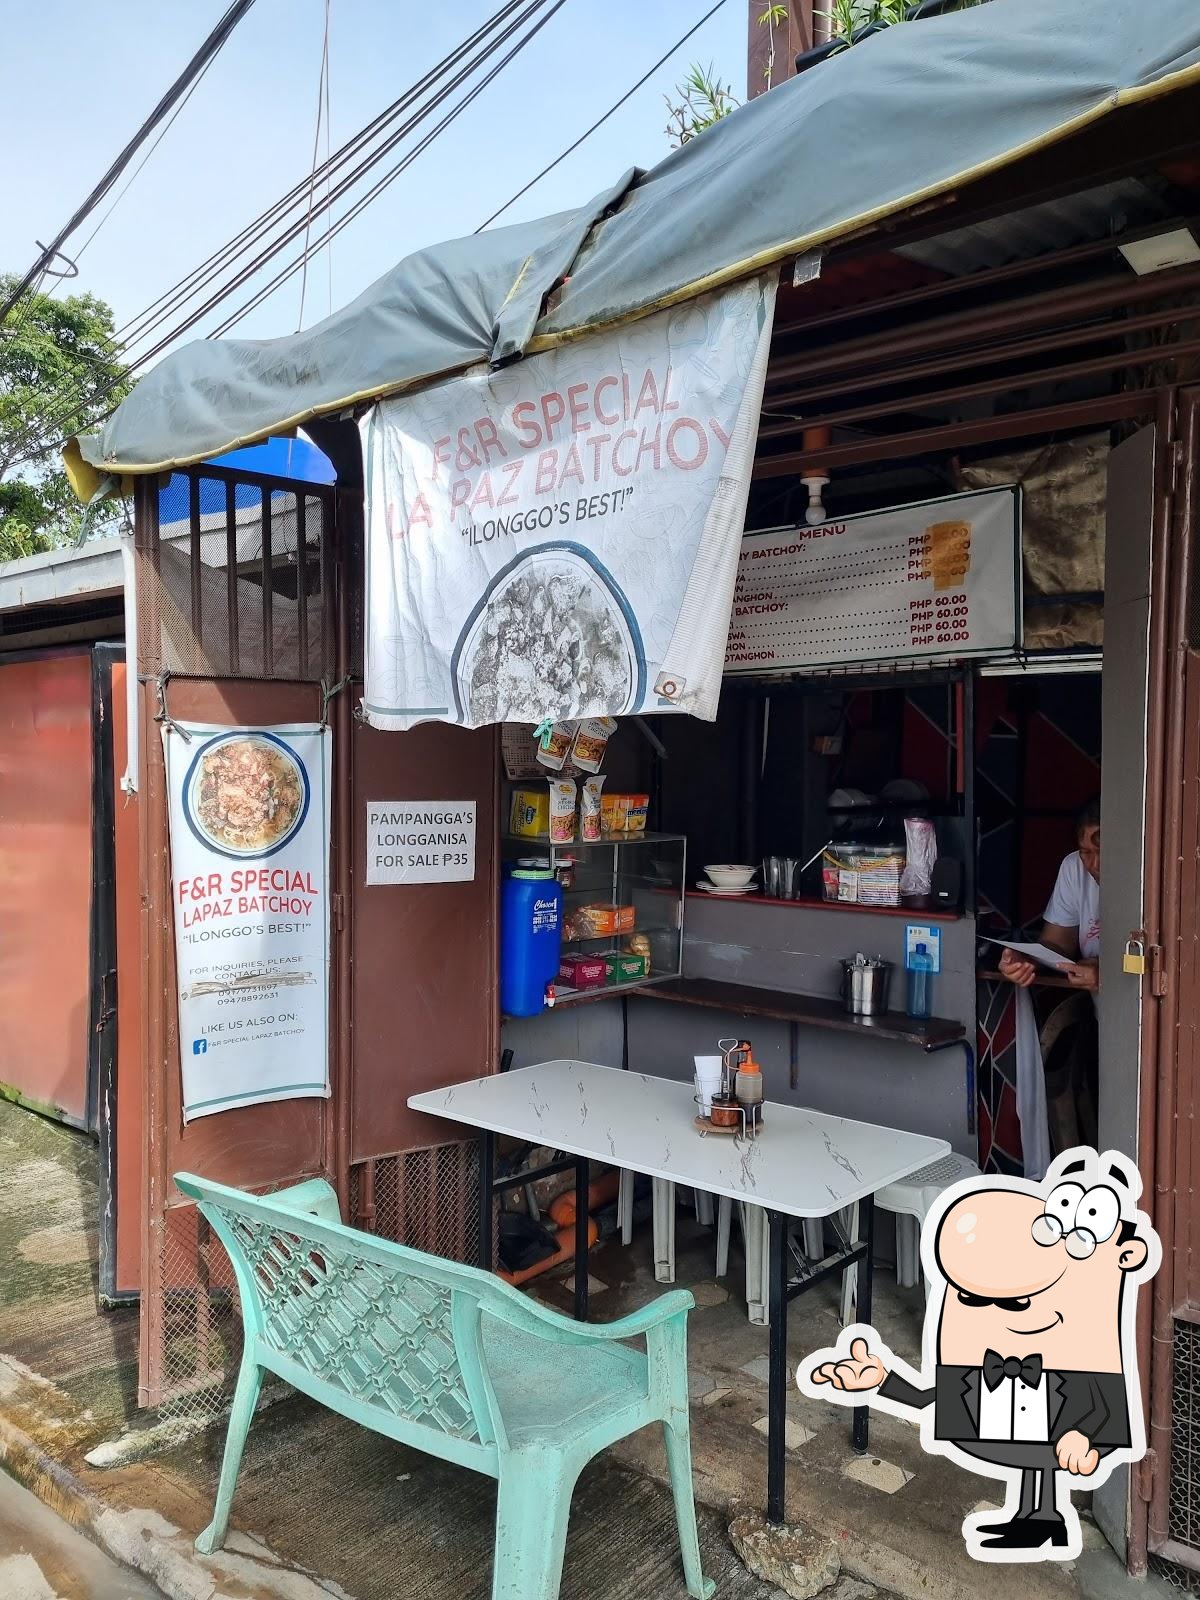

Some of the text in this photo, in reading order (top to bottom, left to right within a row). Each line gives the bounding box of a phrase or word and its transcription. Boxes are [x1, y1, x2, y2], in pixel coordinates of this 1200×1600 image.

[432, 366, 680, 481] F&R SPECIAL
[386, 491, 433, 540] LA
[450, 460, 524, 522] PAZ
[799, 524, 846, 541] MENU
[908, 534, 931, 546] PHP
[751, 543, 806, 560] BATCHOY:
[909, 546, 932, 557] PHP
[908, 558, 931, 570] PHP
[907, 570, 931, 582] PHP
[735, 603, 788, 616] BATCHOY:
[910, 594, 967, 610] PHP 60.00
[911, 611, 934, 622] PHP
[936, 606, 969, 618] 60.00
[911, 623, 933, 634] PHP
[935, 619, 967, 631] 60.00
[912, 635, 934, 646] PHP
[937, 631, 970, 643] 60.00
[377, 833, 467, 846] LONGGANISA
[375, 855, 403, 867] FOR
[407, 854, 439, 867] SALE
[179, 869, 318, 905] F&R SPECIAL
[183, 895, 312, 929] LAPAZ BATCHOY
[189, 966, 209, 975] FOR
[267, 955, 304, 966] PLEASE
[214, 968, 261, 980] CONTACT
[201, 1013, 298, 1035] LIKE US ALSO ON:
[223, 1036, 249, 1046] SPECIAL
[251, 1032, 273, 1041] LAPAZ
[274, 1027, 305, 1037] BATCHOY
